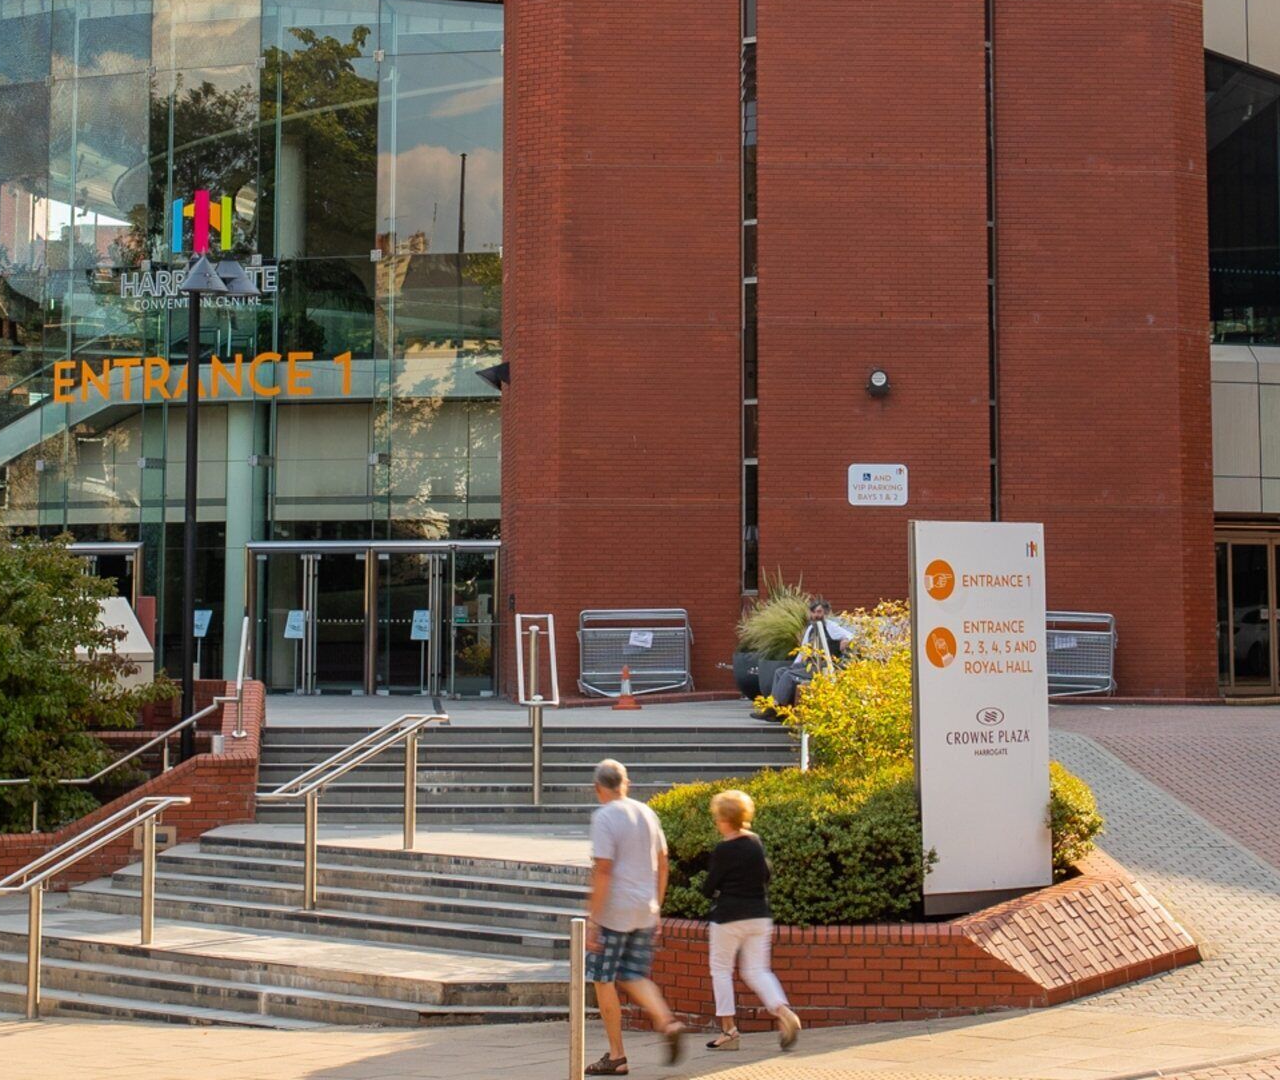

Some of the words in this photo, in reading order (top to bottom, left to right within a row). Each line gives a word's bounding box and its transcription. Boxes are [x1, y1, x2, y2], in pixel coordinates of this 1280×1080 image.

[120, 266, 278, 298] HARRTE
[333, 351, 352, 395] 1
[962, 574, 1024, 587] ENTRANCE
[1025, 574, 1031, 587] 1
[963, 620, 1025, 633] ENTRANCE
[1005, 640, 1011, 653] 5
[1015, 640, 1037, 653] AND
[964, 661, 1003, 674] ROYAL
[1006, 660, 1033, 673] HALL
[946, 731, 994, 745] CROWNE
[998, 729, 1030, 743] PLAZA
[974, 748, 1008, 756] HARROGATE
